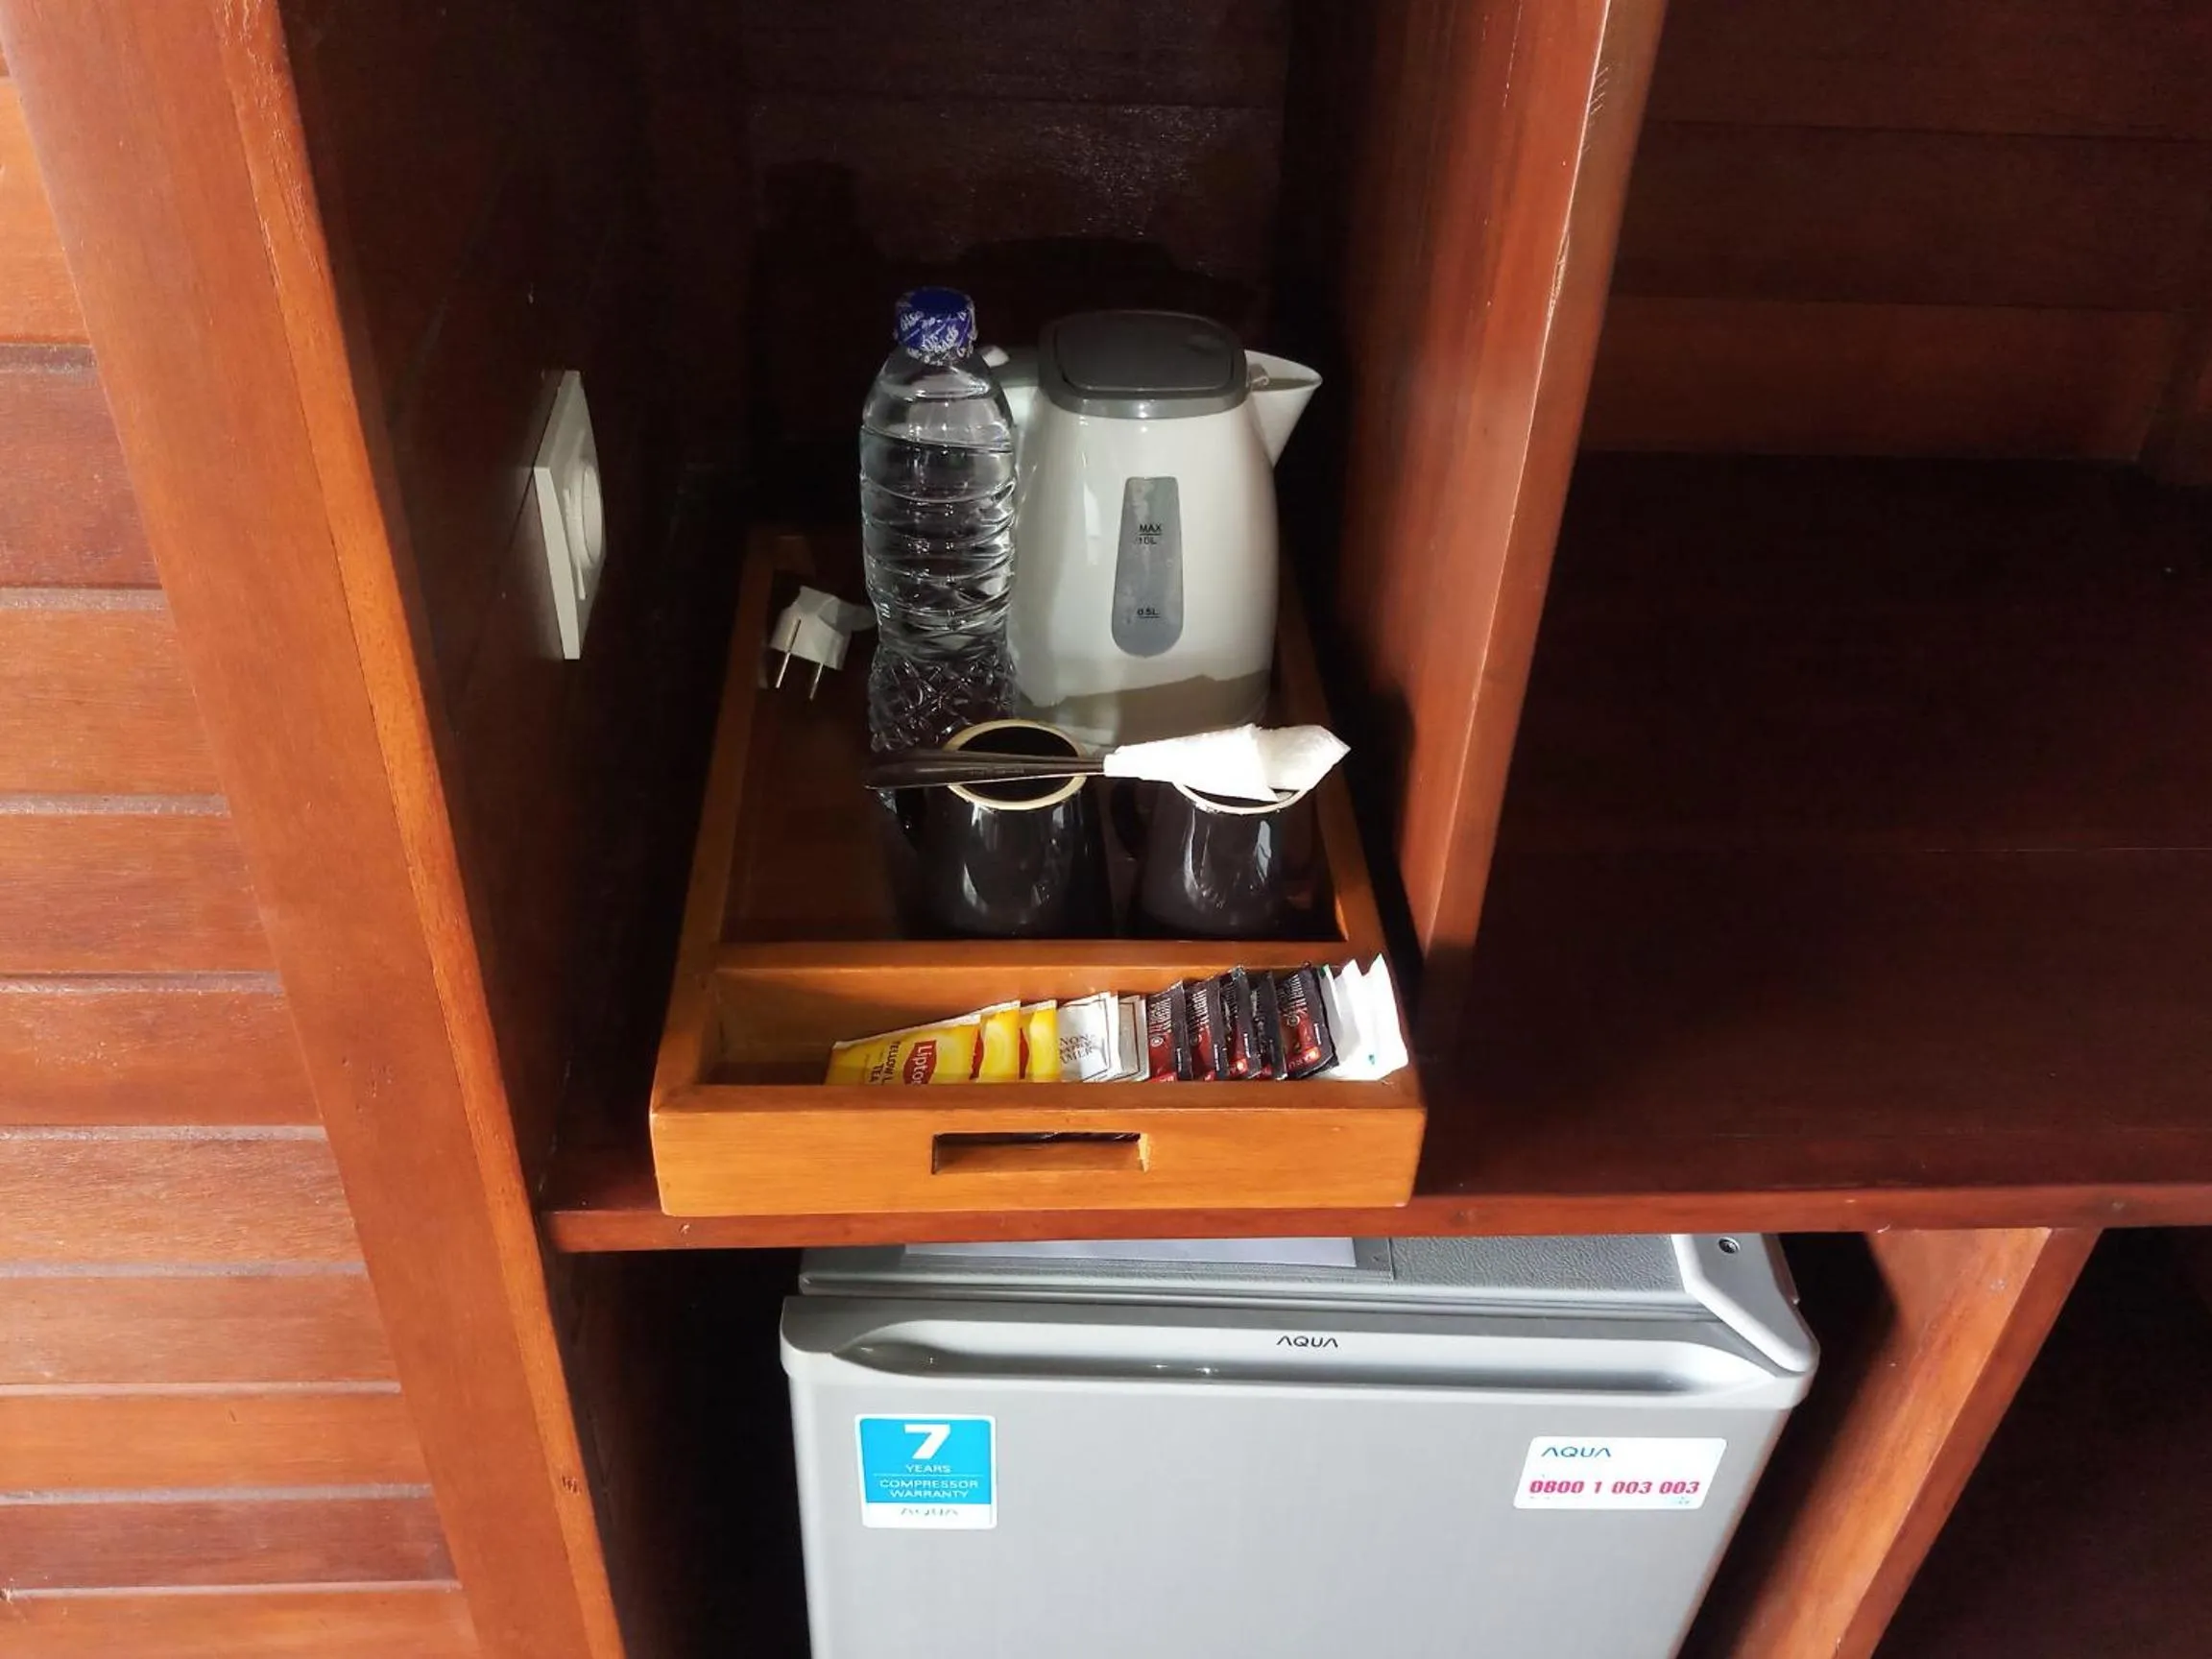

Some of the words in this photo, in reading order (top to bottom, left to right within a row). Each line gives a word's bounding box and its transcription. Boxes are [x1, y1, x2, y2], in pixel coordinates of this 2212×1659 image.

[1139, 523, 1162, 533] MAX
[1276, 1335, 1338, 1348] AQUA
[904, 1424, 951, 1460] 7
[1541, 1446, 1612, 1457] AQUA
[905, 1464, 951, 1474] YEARS
[879, 1479, 978, 1488] COMPRESSOR
[1529, 1480, 1585, 1494] 0800
[1594, 1481, 1602, 1494] 1
[1611, 1481, 1652, 1494] 003
[1659, 1481, 1700, 1494] 003
[890, 1490, 969, 1499] WARRANTY
